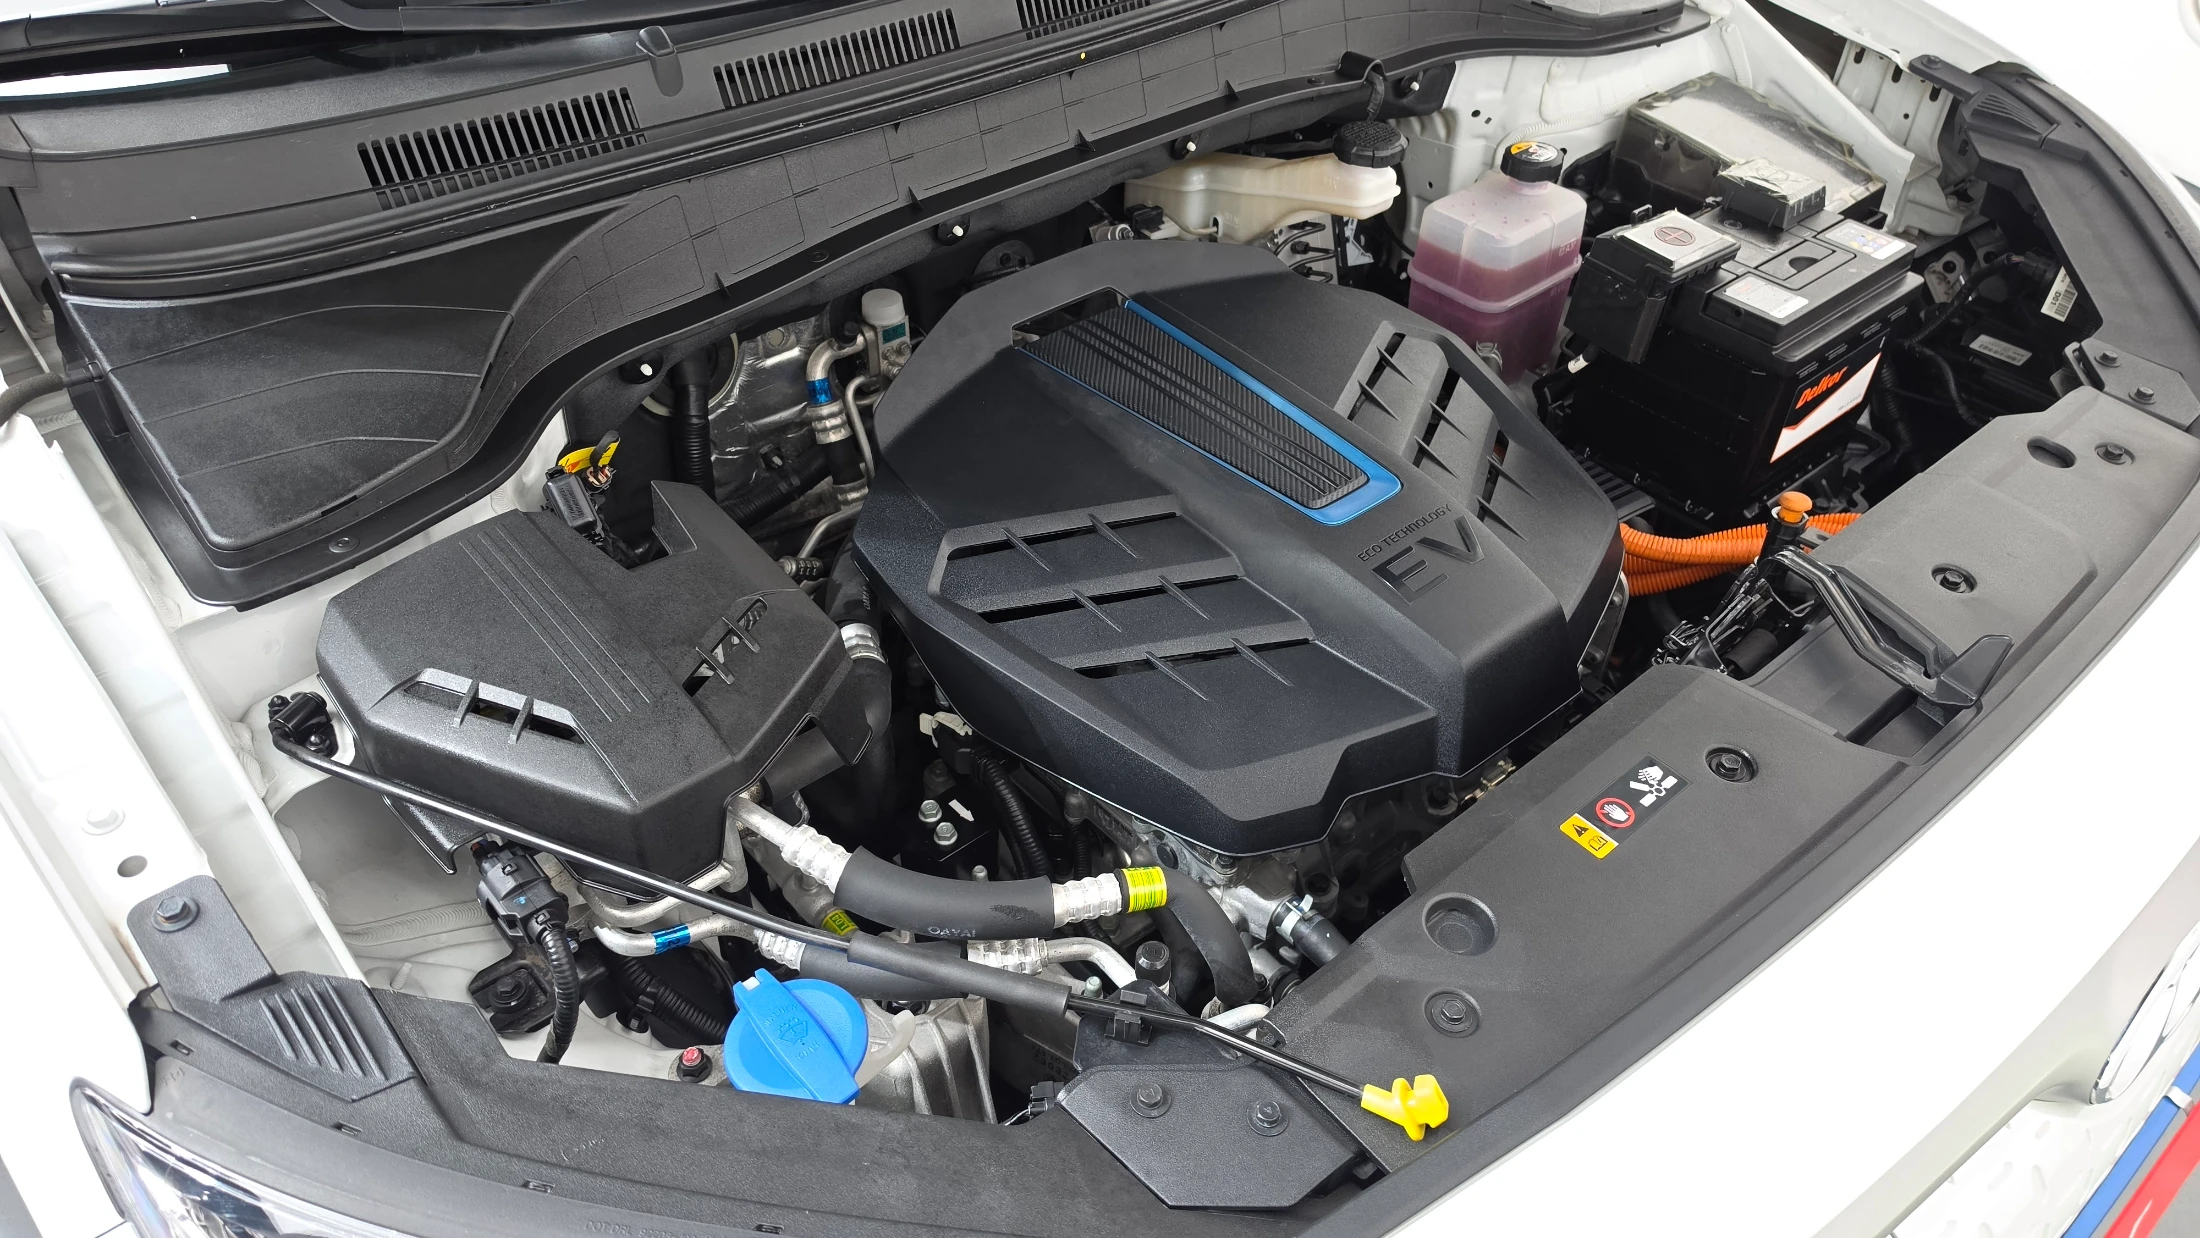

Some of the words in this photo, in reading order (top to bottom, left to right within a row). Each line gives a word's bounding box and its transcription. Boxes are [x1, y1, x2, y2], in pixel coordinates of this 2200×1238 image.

[2050, 291, 2062, 306] D01
[1795, 365, 1849, 410] Delkor
[1357, 544, 1382, 562] ECO
[1381, 503, 1452, 547] TECHNOLOGY
[1371, 514, 1485, 605] EV
[832, 914, 849, 930] L04
